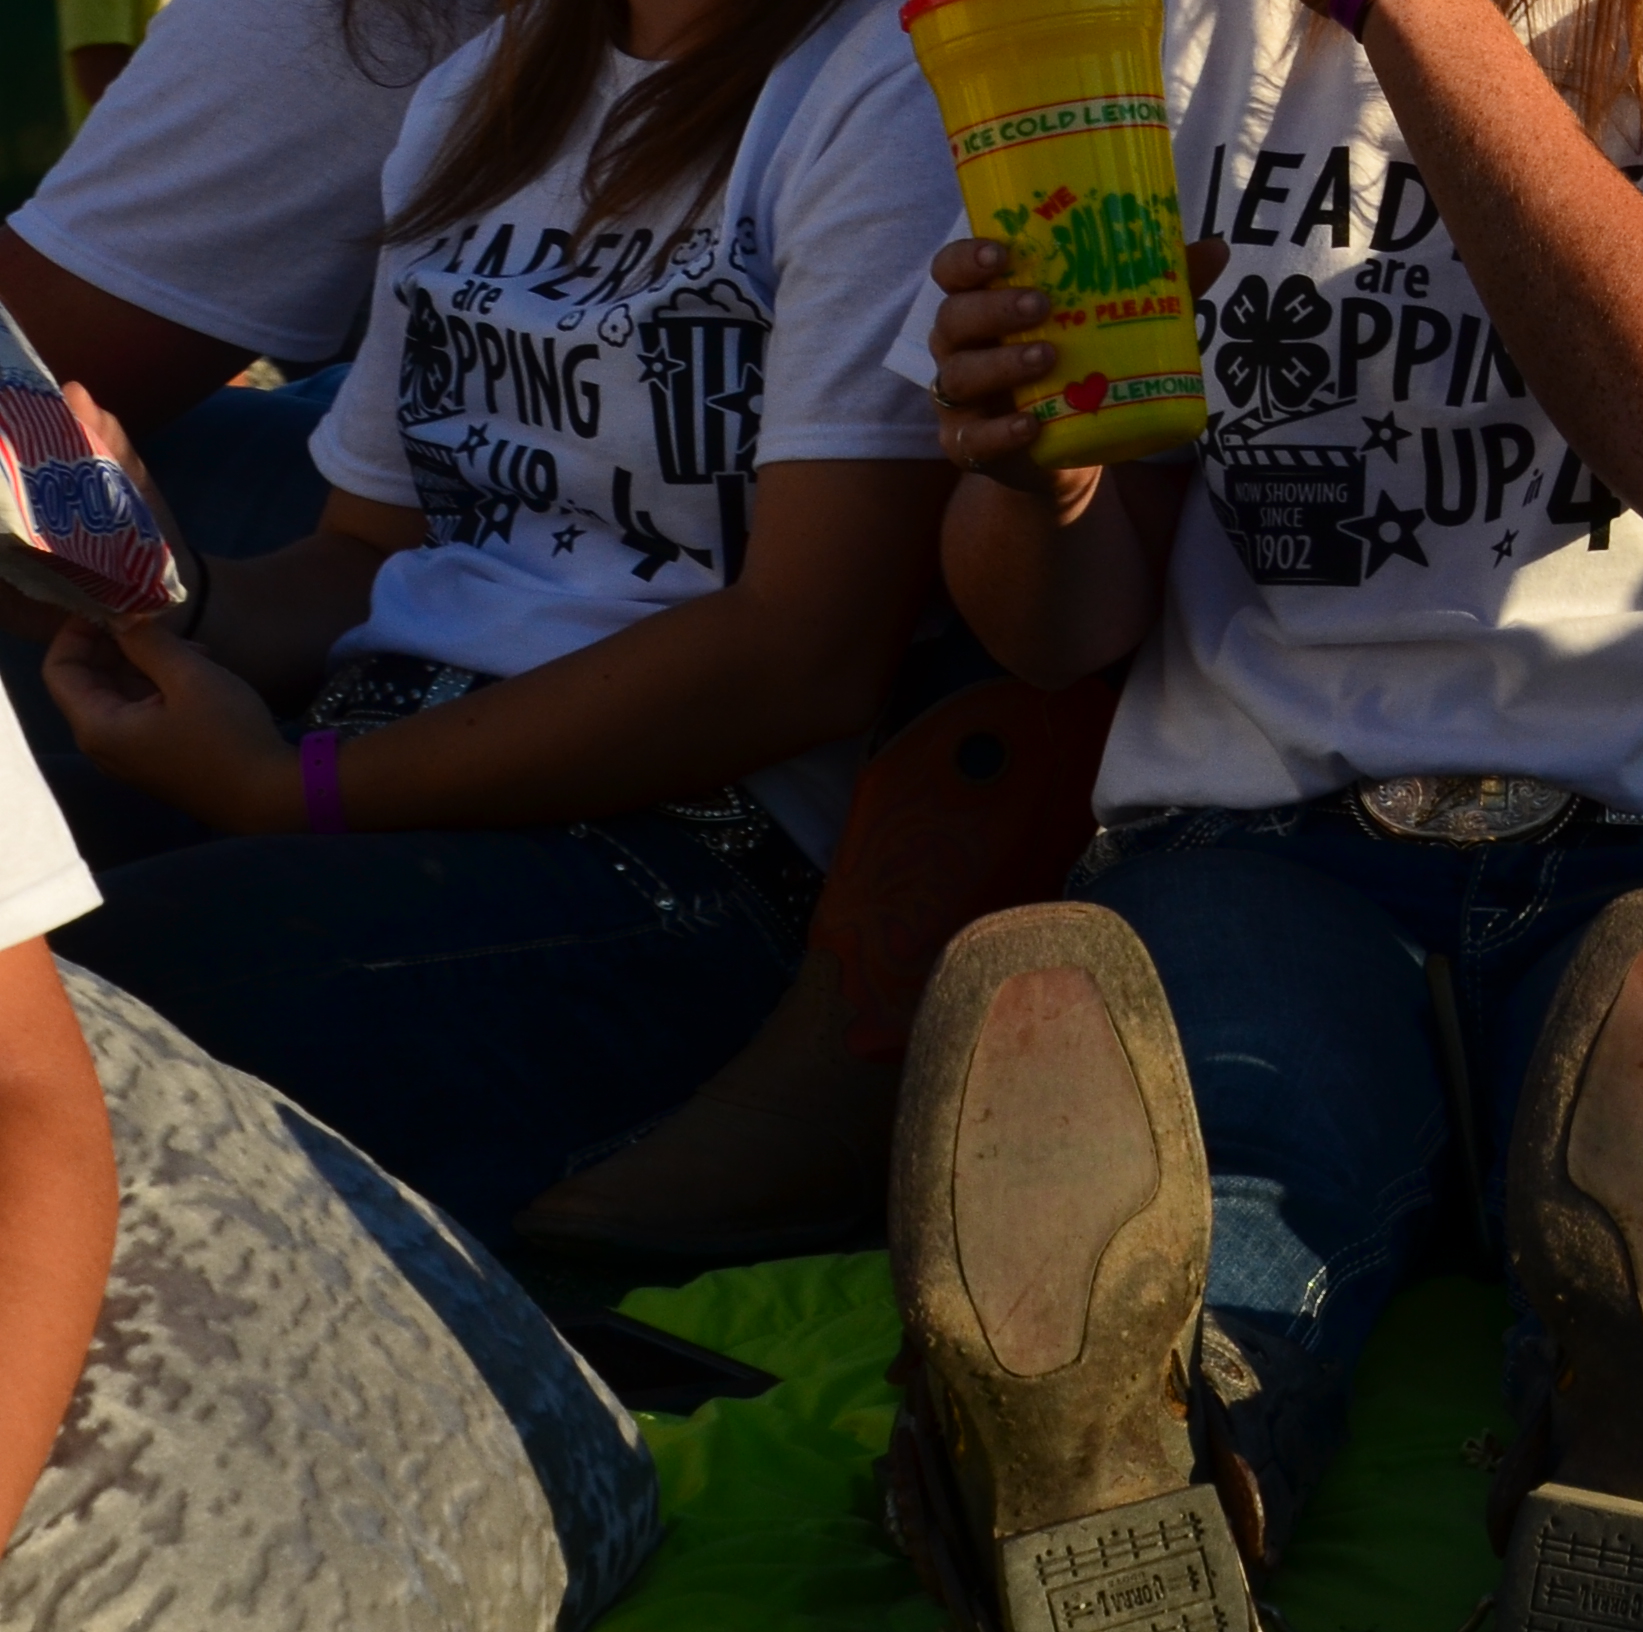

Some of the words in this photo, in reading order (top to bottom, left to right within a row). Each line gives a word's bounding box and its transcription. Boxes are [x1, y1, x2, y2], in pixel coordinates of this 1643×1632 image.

[962, 125, 1001, 156] ICE
[1001, 106, 1076, 142] COLD
[1083, 96, 1169, 129] LEMON
[1033, 185, 1078, 223] WE
[1202, 143, 1452, 254] LEAD
[1355, 255, 1430, 299] are
[452, 279, 502, 315] are
[1054, 311, 1088, 329] TO
[1422, 421, 1536, 527] UP
[1234, 481, 1262, 504] NOW
[1264, 482, 1349, 505] SHOWING
[1259, 506, 1303, 529] SINCE
[1255, 534, 1312, 570] 1902
